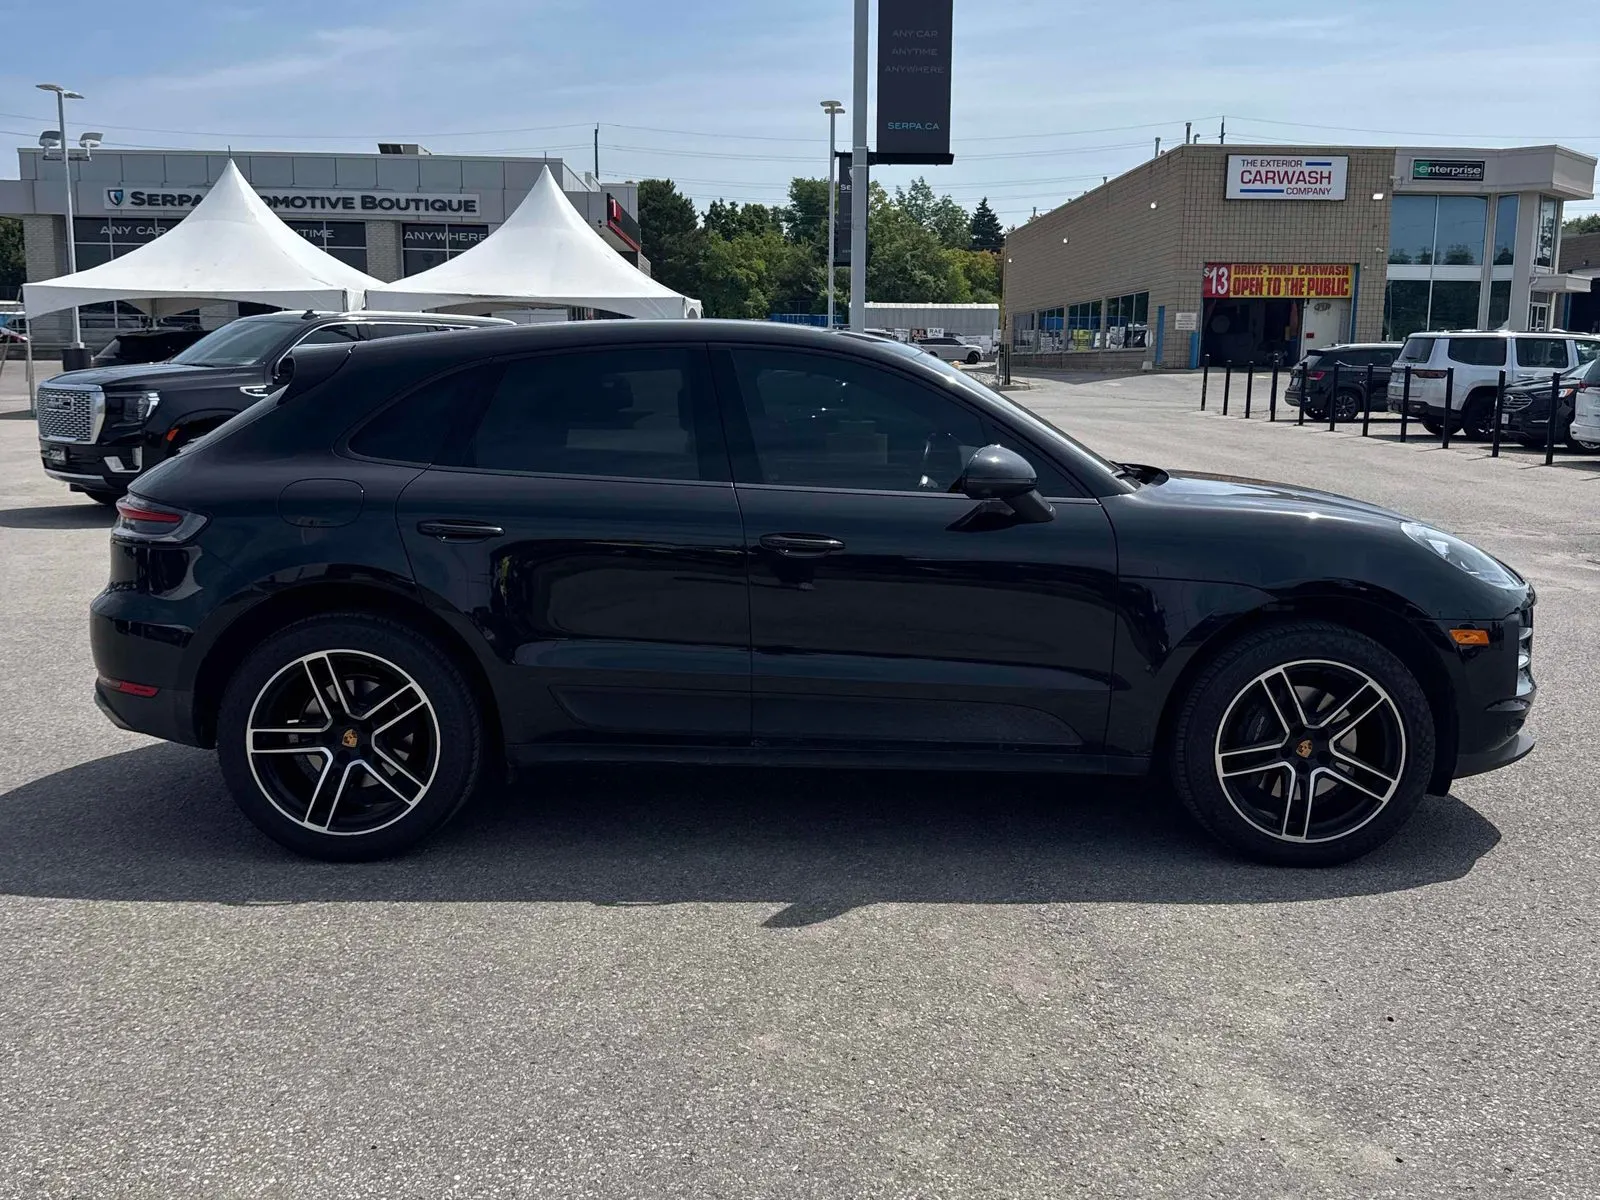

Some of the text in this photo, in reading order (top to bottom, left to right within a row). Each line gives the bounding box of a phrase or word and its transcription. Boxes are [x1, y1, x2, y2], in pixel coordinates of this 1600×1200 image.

[892, 30, 938, 38] ANY CAR
[892, 48, 938, 56] ANYTIME
[885, 65, 945, 73] ANYWHERE
[887, 122, 940, 130] SERPA.CA
[1241, 159, 1302, 168] THE EXTERIOR
[1417, 165, 1481, 176] enterprise
[1240, 170, 1332, 185] CARWASH
[1286, 187, 1332, 195] COMPANY
[261, 195, 355, 210] OMOTIVE
[361, 195, 477, 213] BOUTIQUE
[100, 226, 132, 235] ANY
[1298, 265, 1349, 276] CARWASH
[1232, 277, 1350, 296] OPEN TO THE PUBLIC
